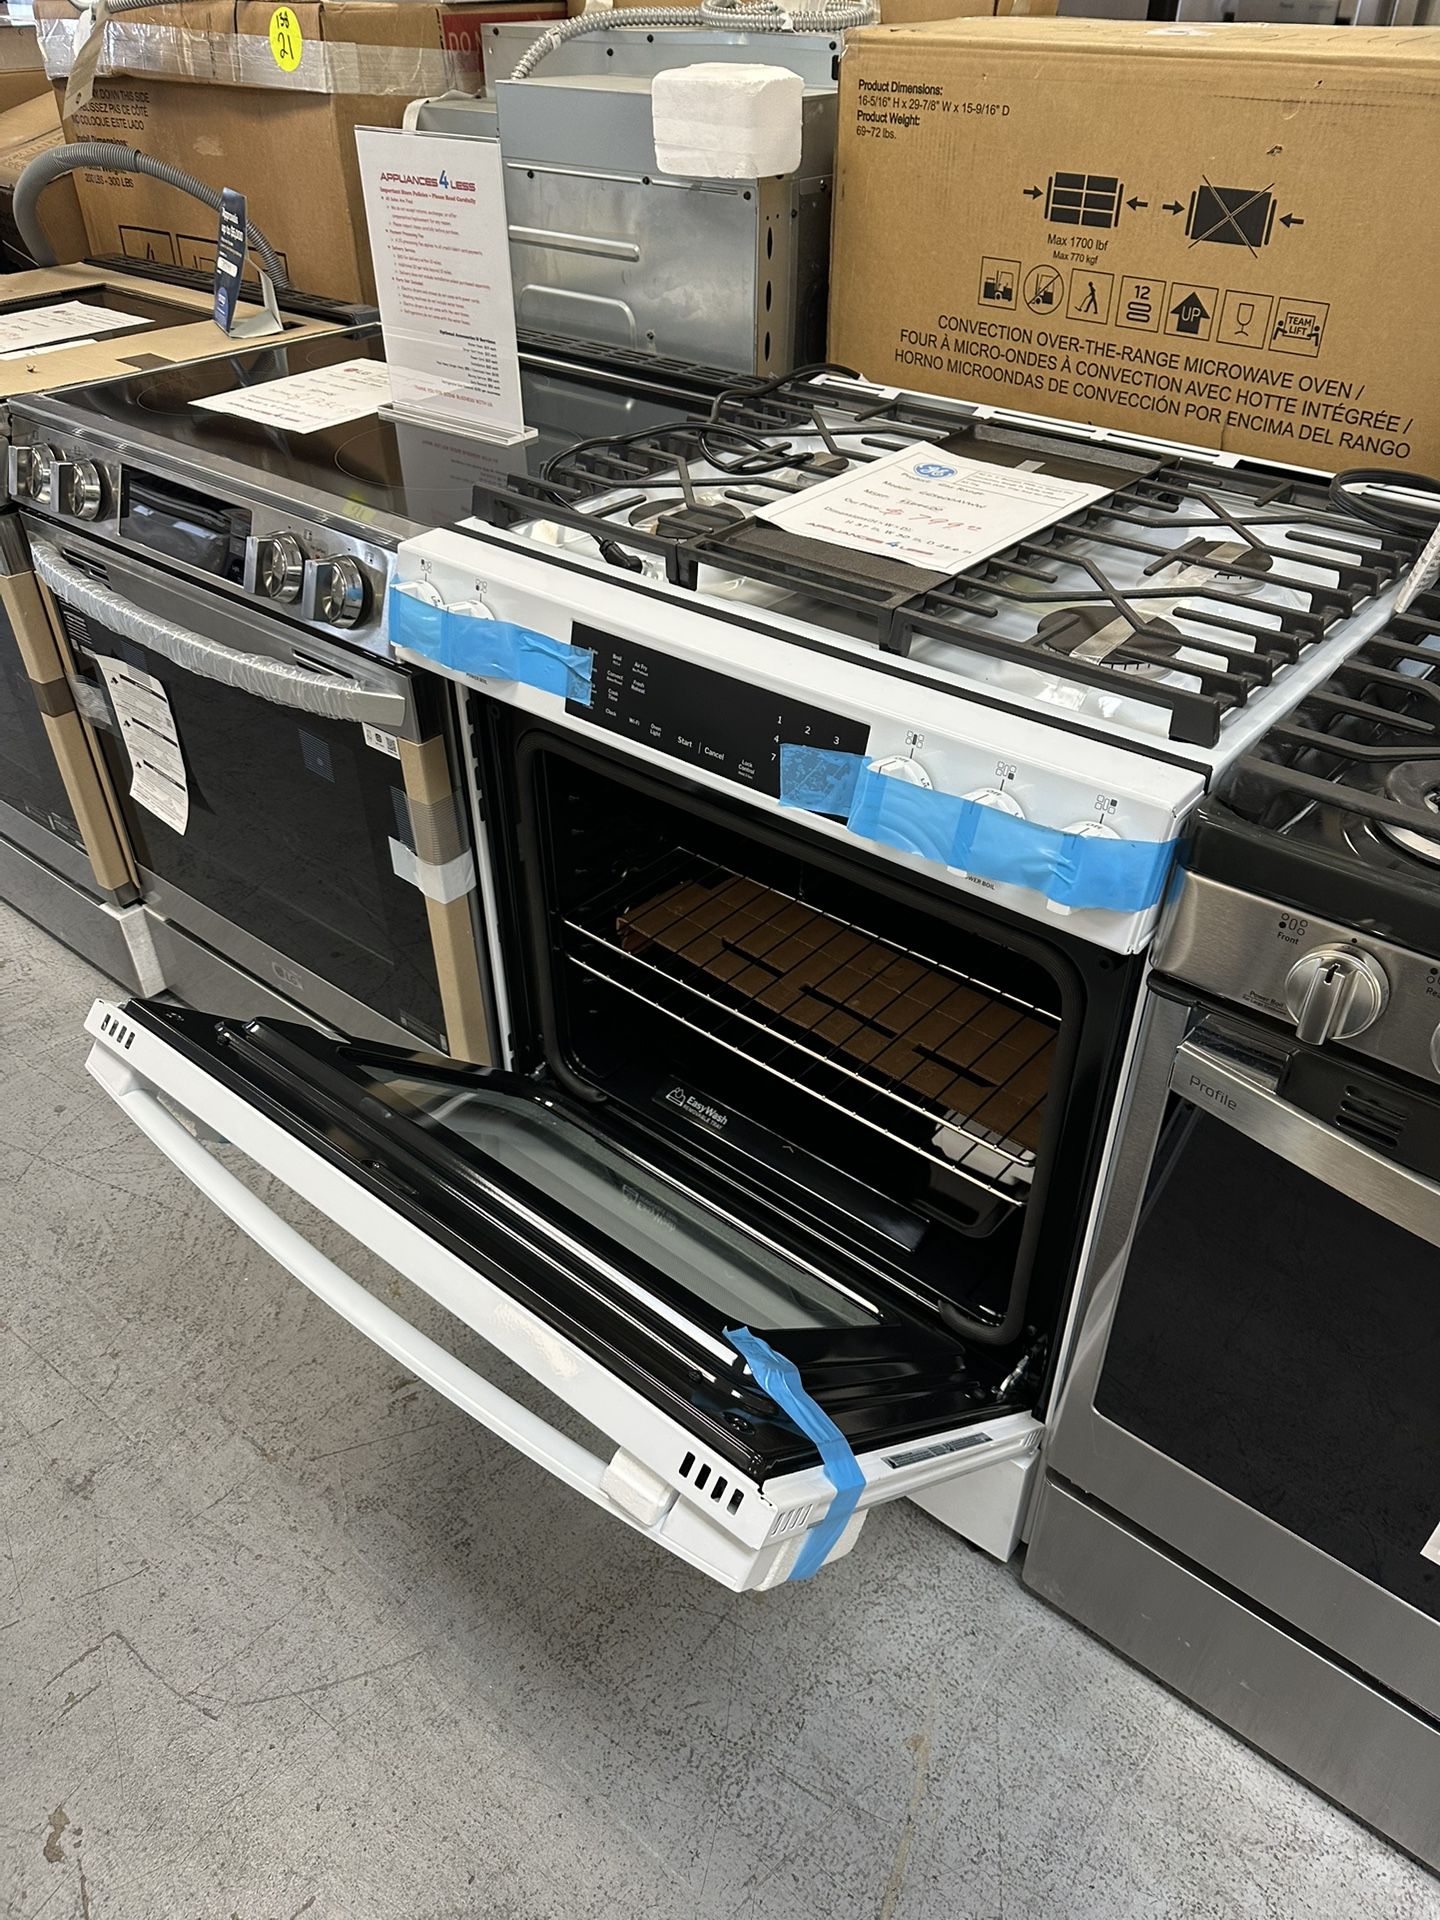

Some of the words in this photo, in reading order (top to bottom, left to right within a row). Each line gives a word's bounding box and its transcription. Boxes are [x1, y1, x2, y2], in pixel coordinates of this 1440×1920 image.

[277, 32, 294, 60] 21
[858, 79, 890, 93] Product
[890, 81, 944, 96] Dimensions:
[100, 89, 119, 100] DOWN
[120, 90, 135, 102] THIS
[135, 91, 150, 103] SIDE
[109, 104, 121, 114] PAS
[121, 105, 130, 114] DE
[858, 95, 891, 107] 16-5/16"
[892, 97, 900, 108] H
[901, 101, 907, 109] x
[908, 98, 940, 111] 29-7/8"
[941, 101, 953, 112] W
[953, 104, 959, 113] x
[962, 102, 1000, 116] 15-9/16"
[1002, 105, 1010, 116] D
[80, 115, 111, 127] COLOQUE
[111, 117, 128, 128] ESTE
[128, 119, 144, 130] LADO
[856, 110, 888, 122] Product
[889, 112, 921, 128] Weight:
[856, 125, 881, 138] 69~72
[882, 128, 897, 140] lbs.
[108, 176, 121, 186] 300
[121, 177, 134, 188] LBS
[380, 172, 439, 187] APPLIANCES
[439, 170, 449, 189] 4
[450, 182, 476, 192] LESS
[1047, 234, 1068, 247] Max
[1070, 236, 1094, 250] 1700
[1095, 239, 1109, 251] lbf
[1053, 250, 1069, 261] Max
[1070, 253, 1085, 263] 770
[1085, 255, 1099, 266] kgf
[1134, 285, 1151, 300] 12
[1181, 306, 1200, 322] UP
[1288, 315, 1312, 328] TEAM
[1288, 325, 1308, 336] LIFT
[937, 314, 1033, 345] CONVECTION
[1036, 331, 1181, 370] OVER-THE-RANGE
[1183, 356, 1294, 389] MICROWAVE
[1298, 375, 1353, 399] OVEN
[1355, 384, 1366, 401] /
[900, 329, 938, 349] FOUR
[940, 332, 951, 351] À
[953, 339, 1058, 371] MICRO-ONDES
[1060, 356, 1073, 373] À
[1075, 360, 1183, 393] CONVECTION
[1185, 380, 1232, 402] AVEC
[1236, 388, 1297, 414] HOTTE
[1301, 400, 1401, 433] INTÉGRÉE
[1402, 418, 1414, 435] /
[894, 348, 944, 370] HORNO
[946, 358, 1044, 390] MICROONDAS
[1049, 377, 1068, 395] DE
[1072, 382, 1181, 416] CONVECCIÓN
[1184, 403, 1222, 424] POR
[1226, 413, 1294, 438] ENCIMA
[1298, 424, 1334, 445] DEL
[1338, 431, 1411, 459] RANGO
[605, 707, 617, 717] Clock
[628, 717, 640, 726] Wi-Fi
[650, 722, 662, 732] Oven
[649, 728, 661, 738] Light
[777, 715, 783, 726] 1
[804, 726, 811, 735] 2
[833, 736, 840, 746] 3
[677, 735, 693, 749] Start
[773, 734, 780, 743] 4
[704, 746, 725, 761] Cancel
[771, 752, 777, 761] 7
[738, 763, 755, 775] Control
[1277, 931, 1300, 946] Front
[1250, 990, 1270, 1003] Power
[1189, 1074, 1237, 1111] Profile
[686, 1096, 728, 1125] EasyWash
